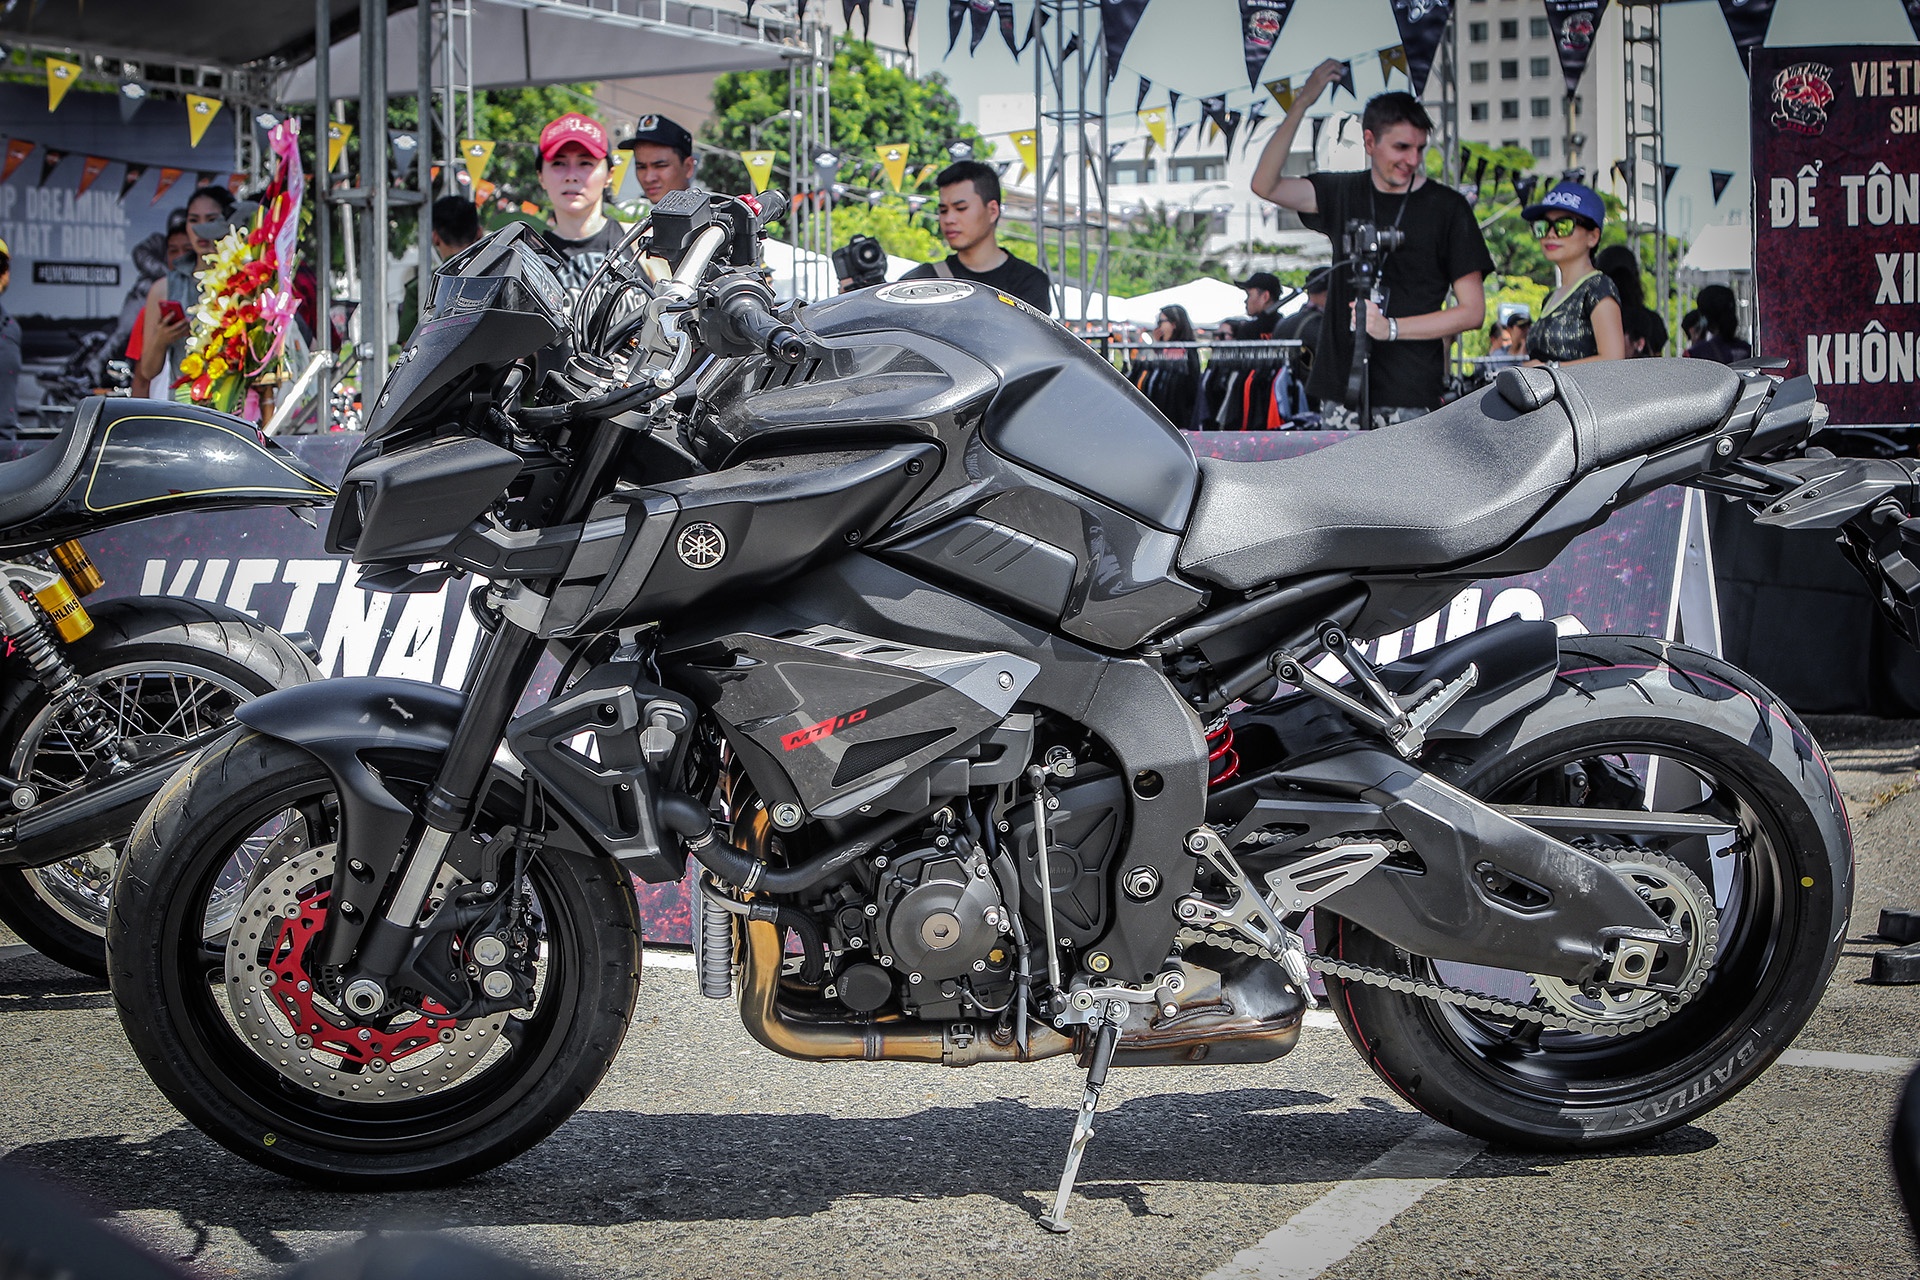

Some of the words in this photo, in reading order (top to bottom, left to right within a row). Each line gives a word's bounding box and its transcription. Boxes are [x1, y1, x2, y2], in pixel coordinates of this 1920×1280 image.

[1890, 105, 1920, 135] SH
[1769, 159, 1824, 228] ĐỂ
[1874, 252, 1920, 305] XI
[1807, 319, 1920, 385] KHÔN
